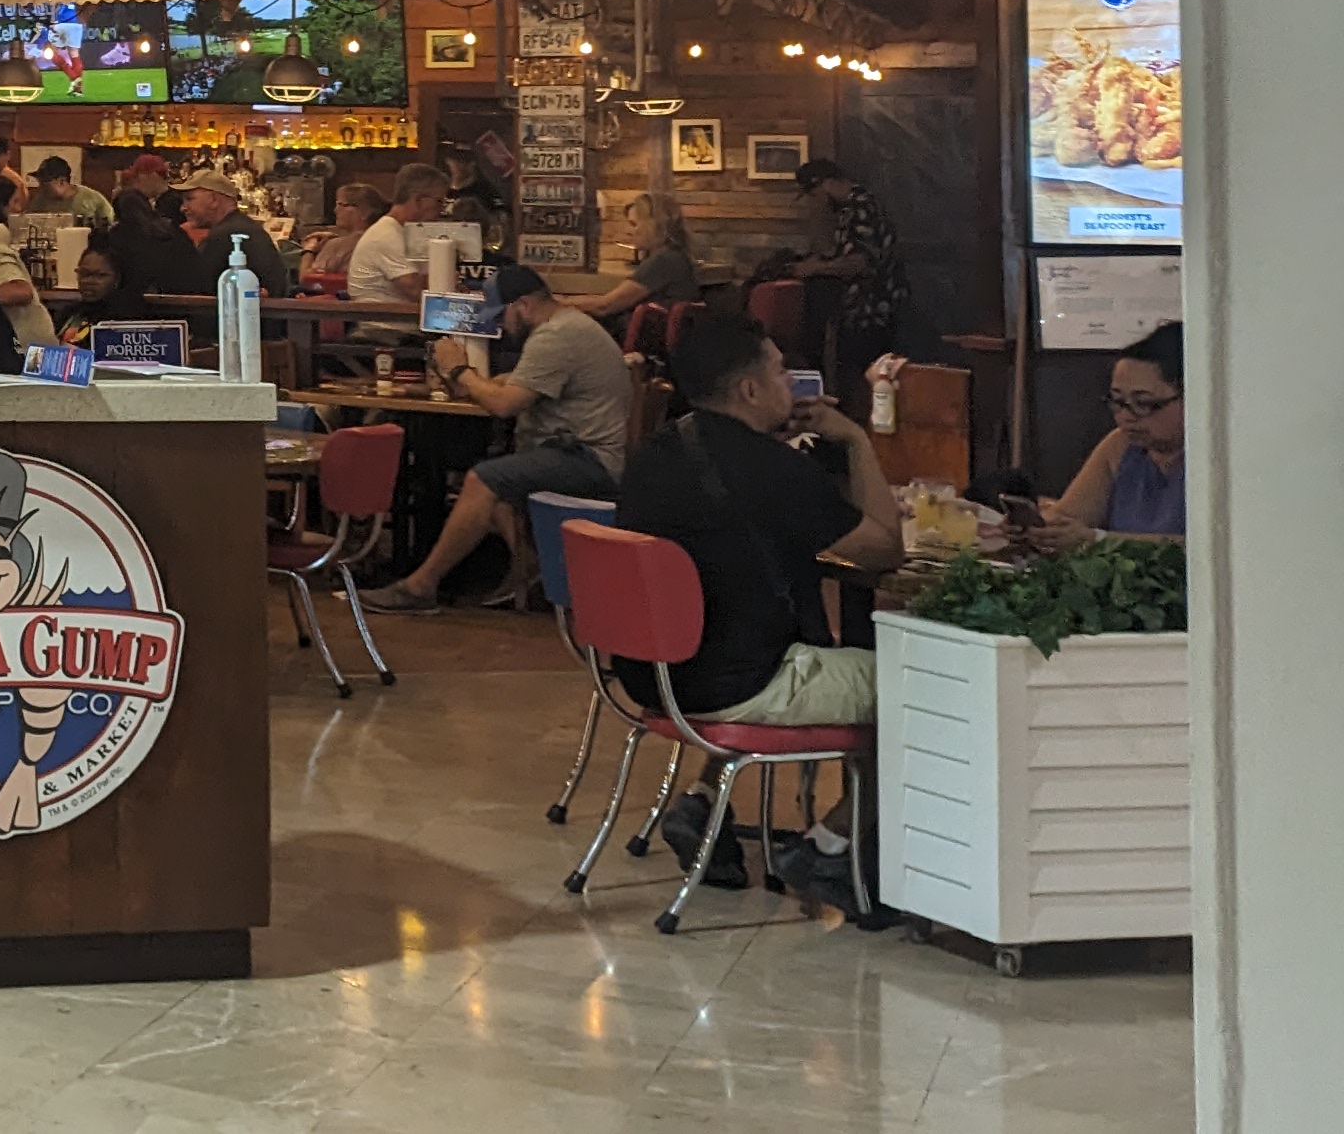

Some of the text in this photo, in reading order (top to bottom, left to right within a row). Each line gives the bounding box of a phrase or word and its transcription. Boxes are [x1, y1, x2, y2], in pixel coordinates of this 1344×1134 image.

[1084, 222, 1132, 230] SEAFOOD
[122, 333, 152, 345] RUN
[19, 615, 168, 684] GUMP
[67, 692, 113, 717] CO.
[42, 781, 60, 797] &
[66, 700, 138, 784] MARKET
